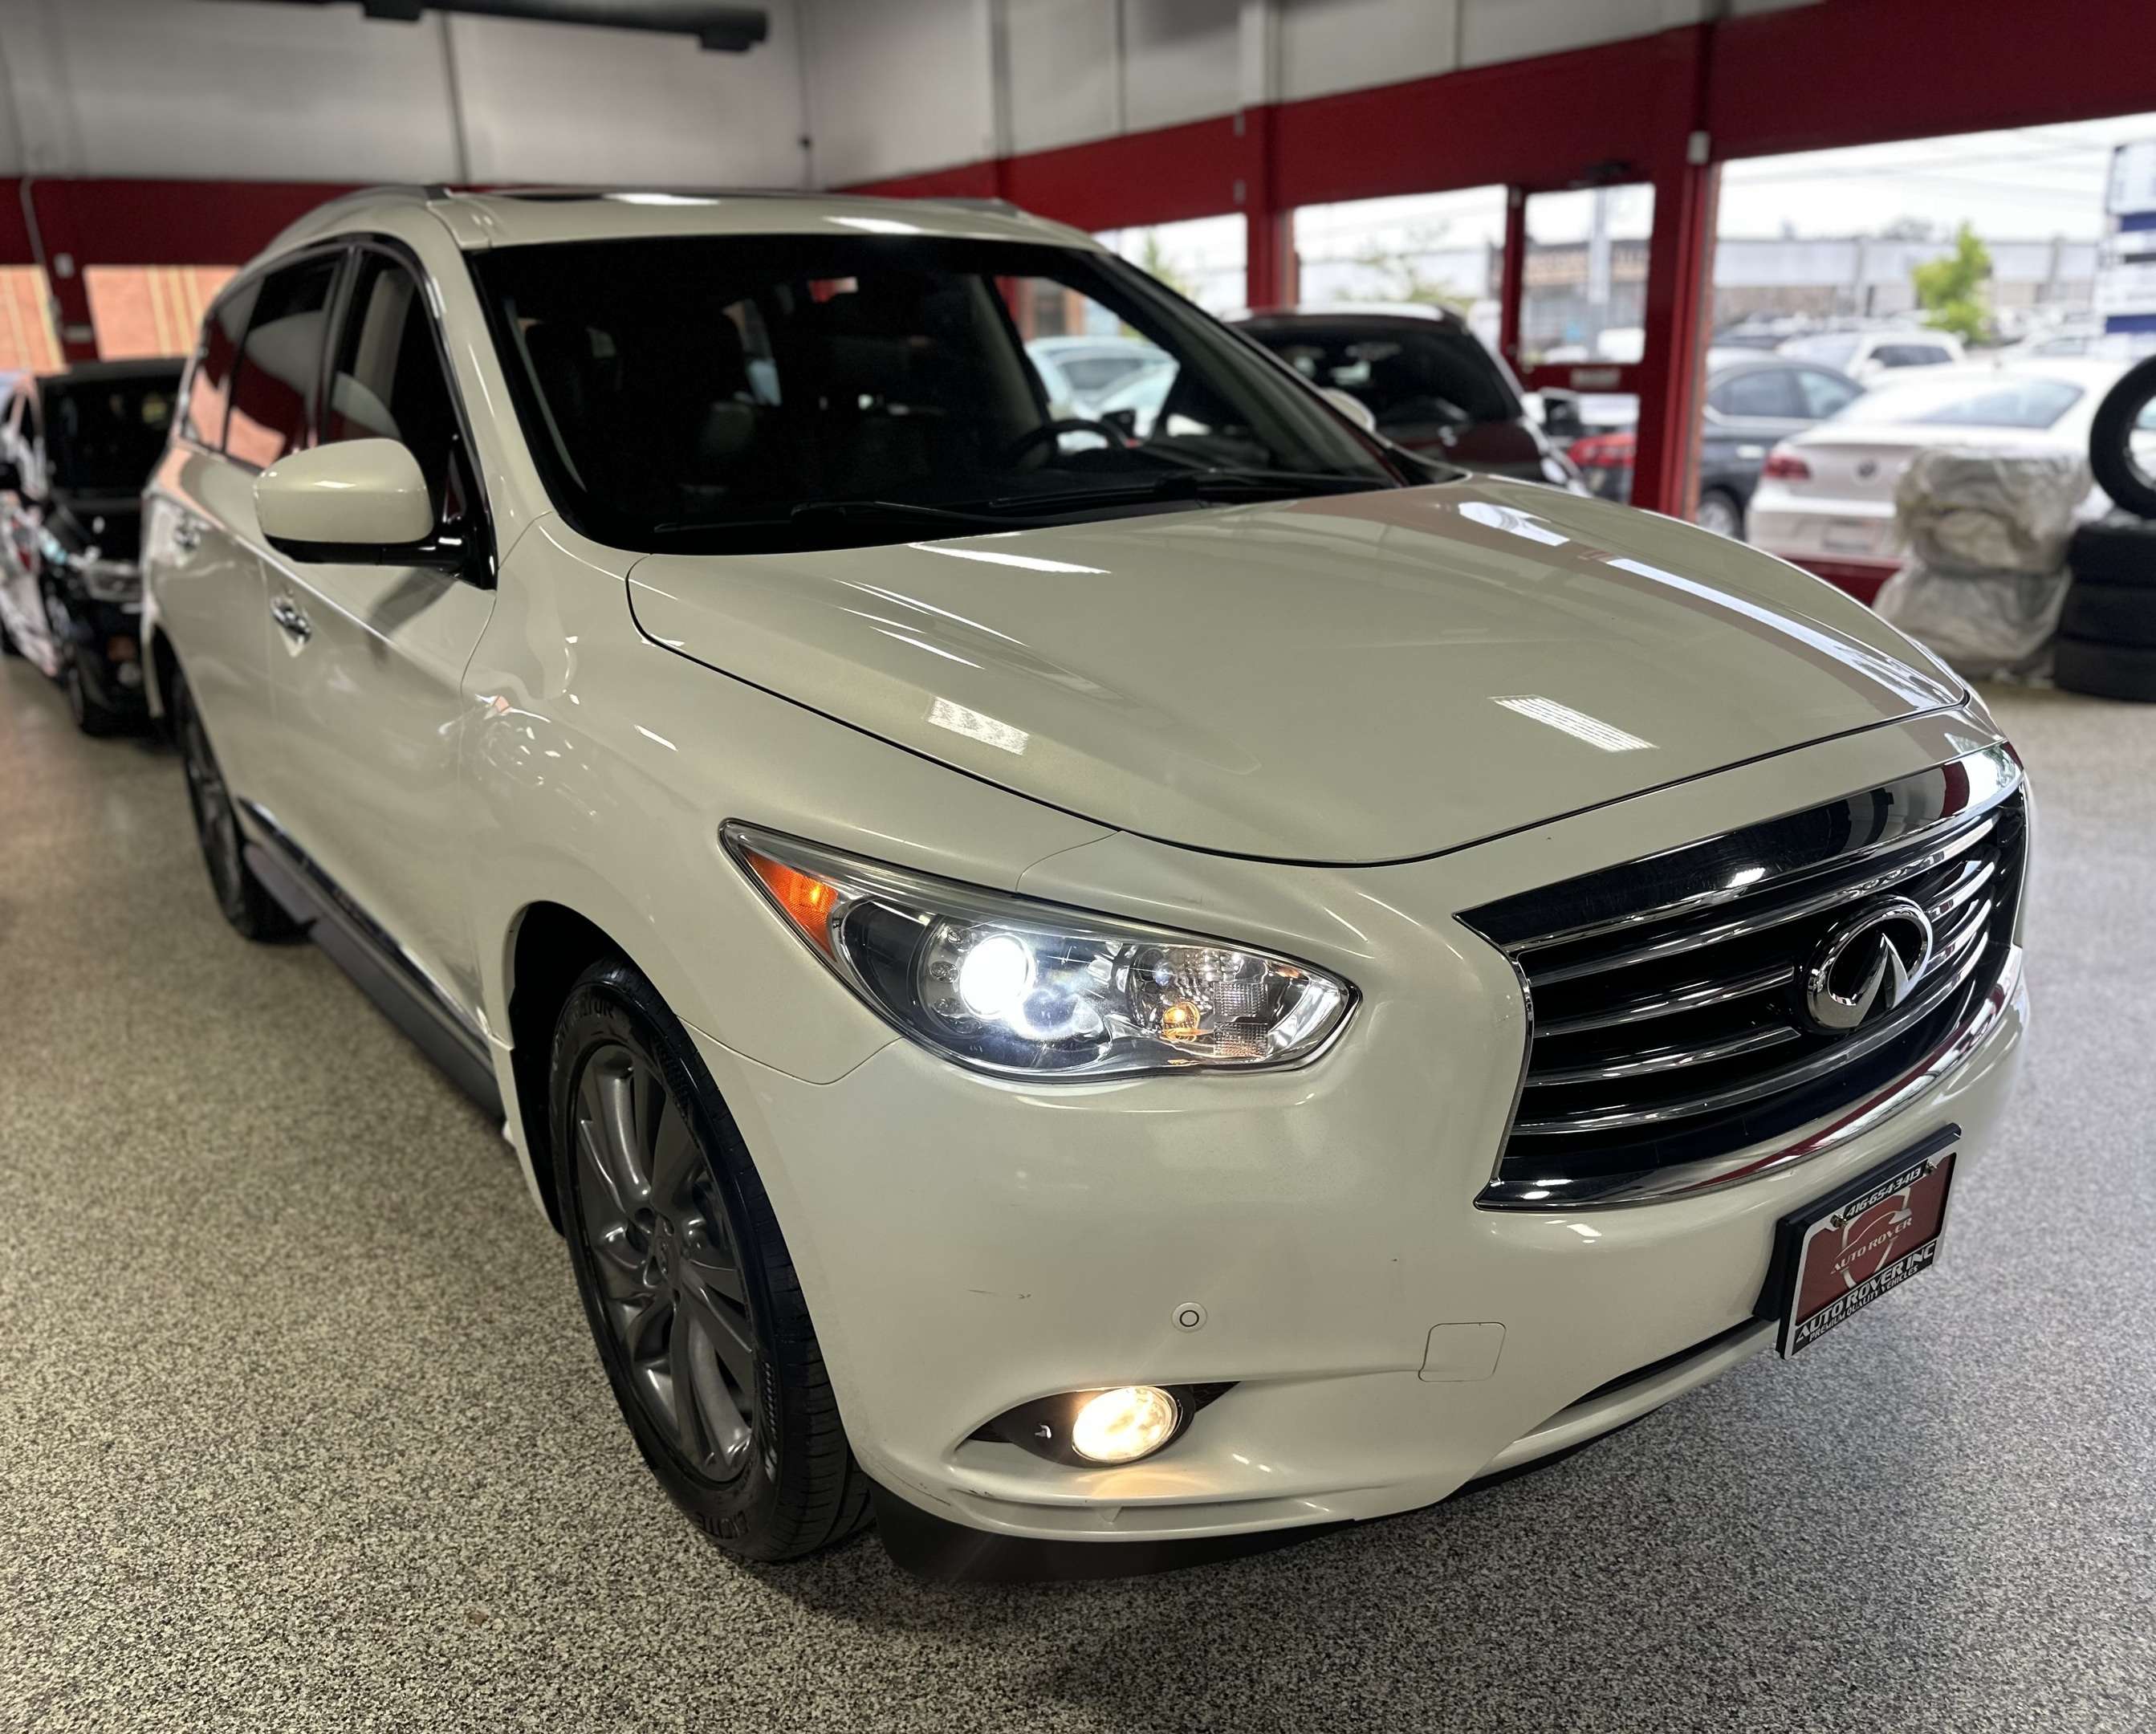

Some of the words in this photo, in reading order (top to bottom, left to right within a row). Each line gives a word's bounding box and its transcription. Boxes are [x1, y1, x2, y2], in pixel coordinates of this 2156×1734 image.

[1830, 1246, 1866, 1275] AUTO
[1868, 1218, 1913, 1250] ROVER
[1796, 1300, 1844, 1344] AUTO
[1845, 1261, 1903, 1309] ROVER
[1906, 1242, 1935, 1270] INC
[1809, 1312, 1846, 1342] PREMIUM
[1846, 1290, 1879, 1317] QUALITY
[1881, 1264, 1918, 1292] VEHICLES
